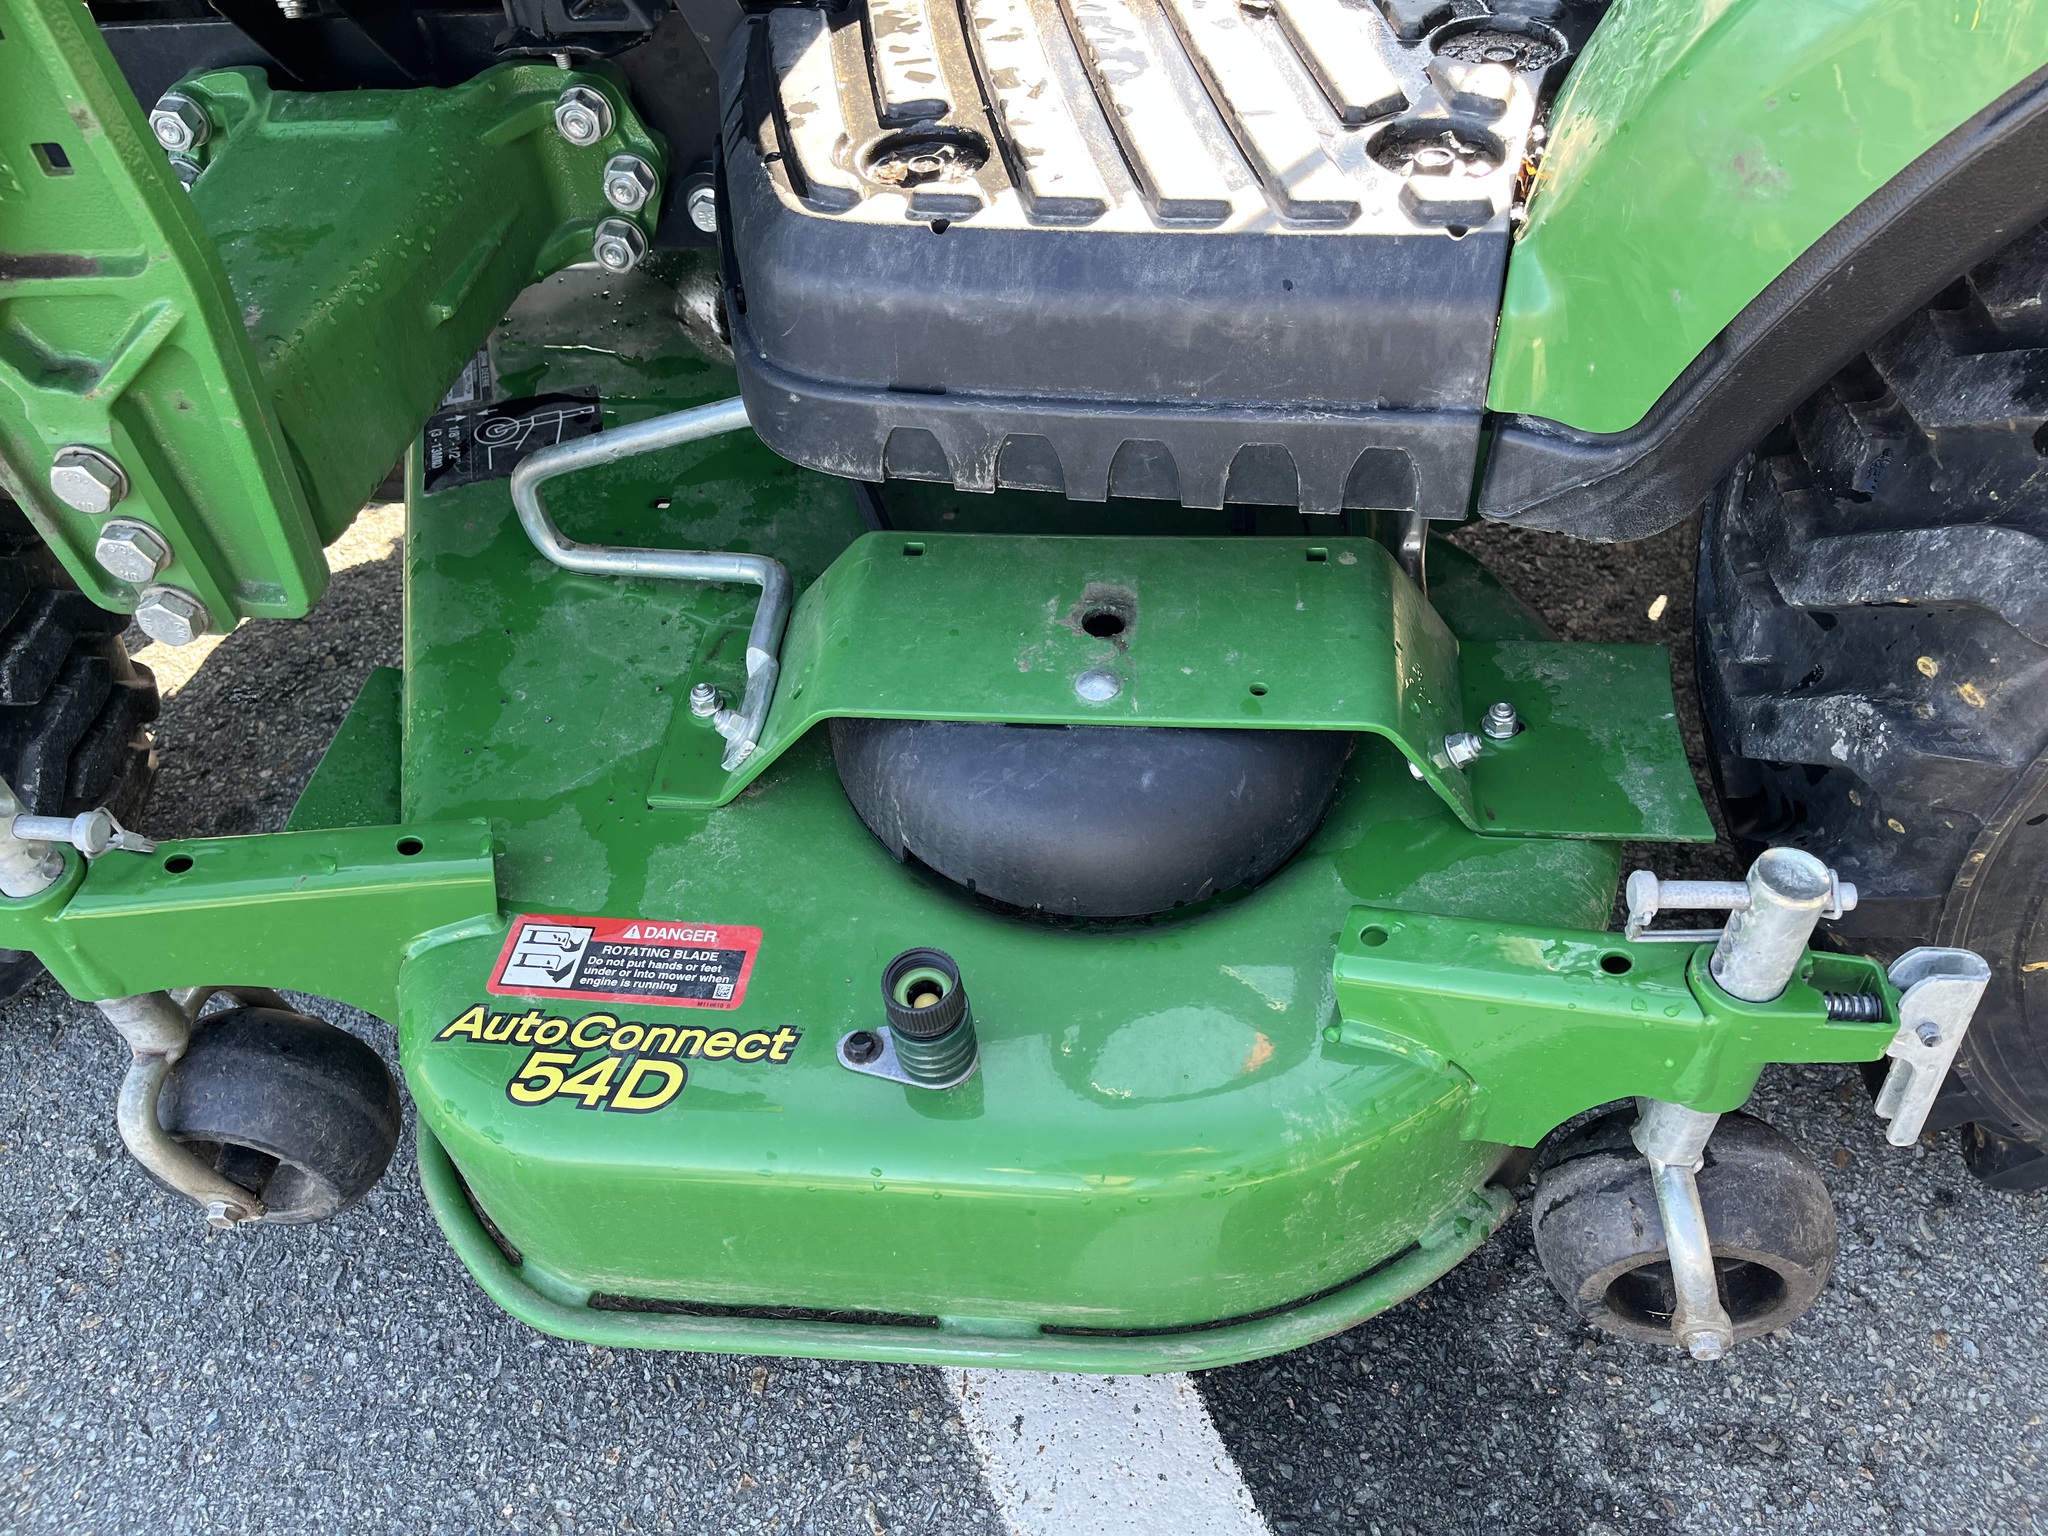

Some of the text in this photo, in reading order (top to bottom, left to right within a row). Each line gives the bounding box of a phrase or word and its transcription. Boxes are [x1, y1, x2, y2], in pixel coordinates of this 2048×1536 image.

[481, 367, 490, 388] DEERE
[643, 926, 718, 943] DANGER
[602, 945, 719, 962] ROTATING BLADE
[587, 956, 723, 974] Do not put hands or feet
[584, 966, 730, 984] under or into mower when
[580, 977, 677, 992] engine is running
[436, 1005, 799, 1062] AutoConnect
[507, 1050, 687, 1112] 54D
